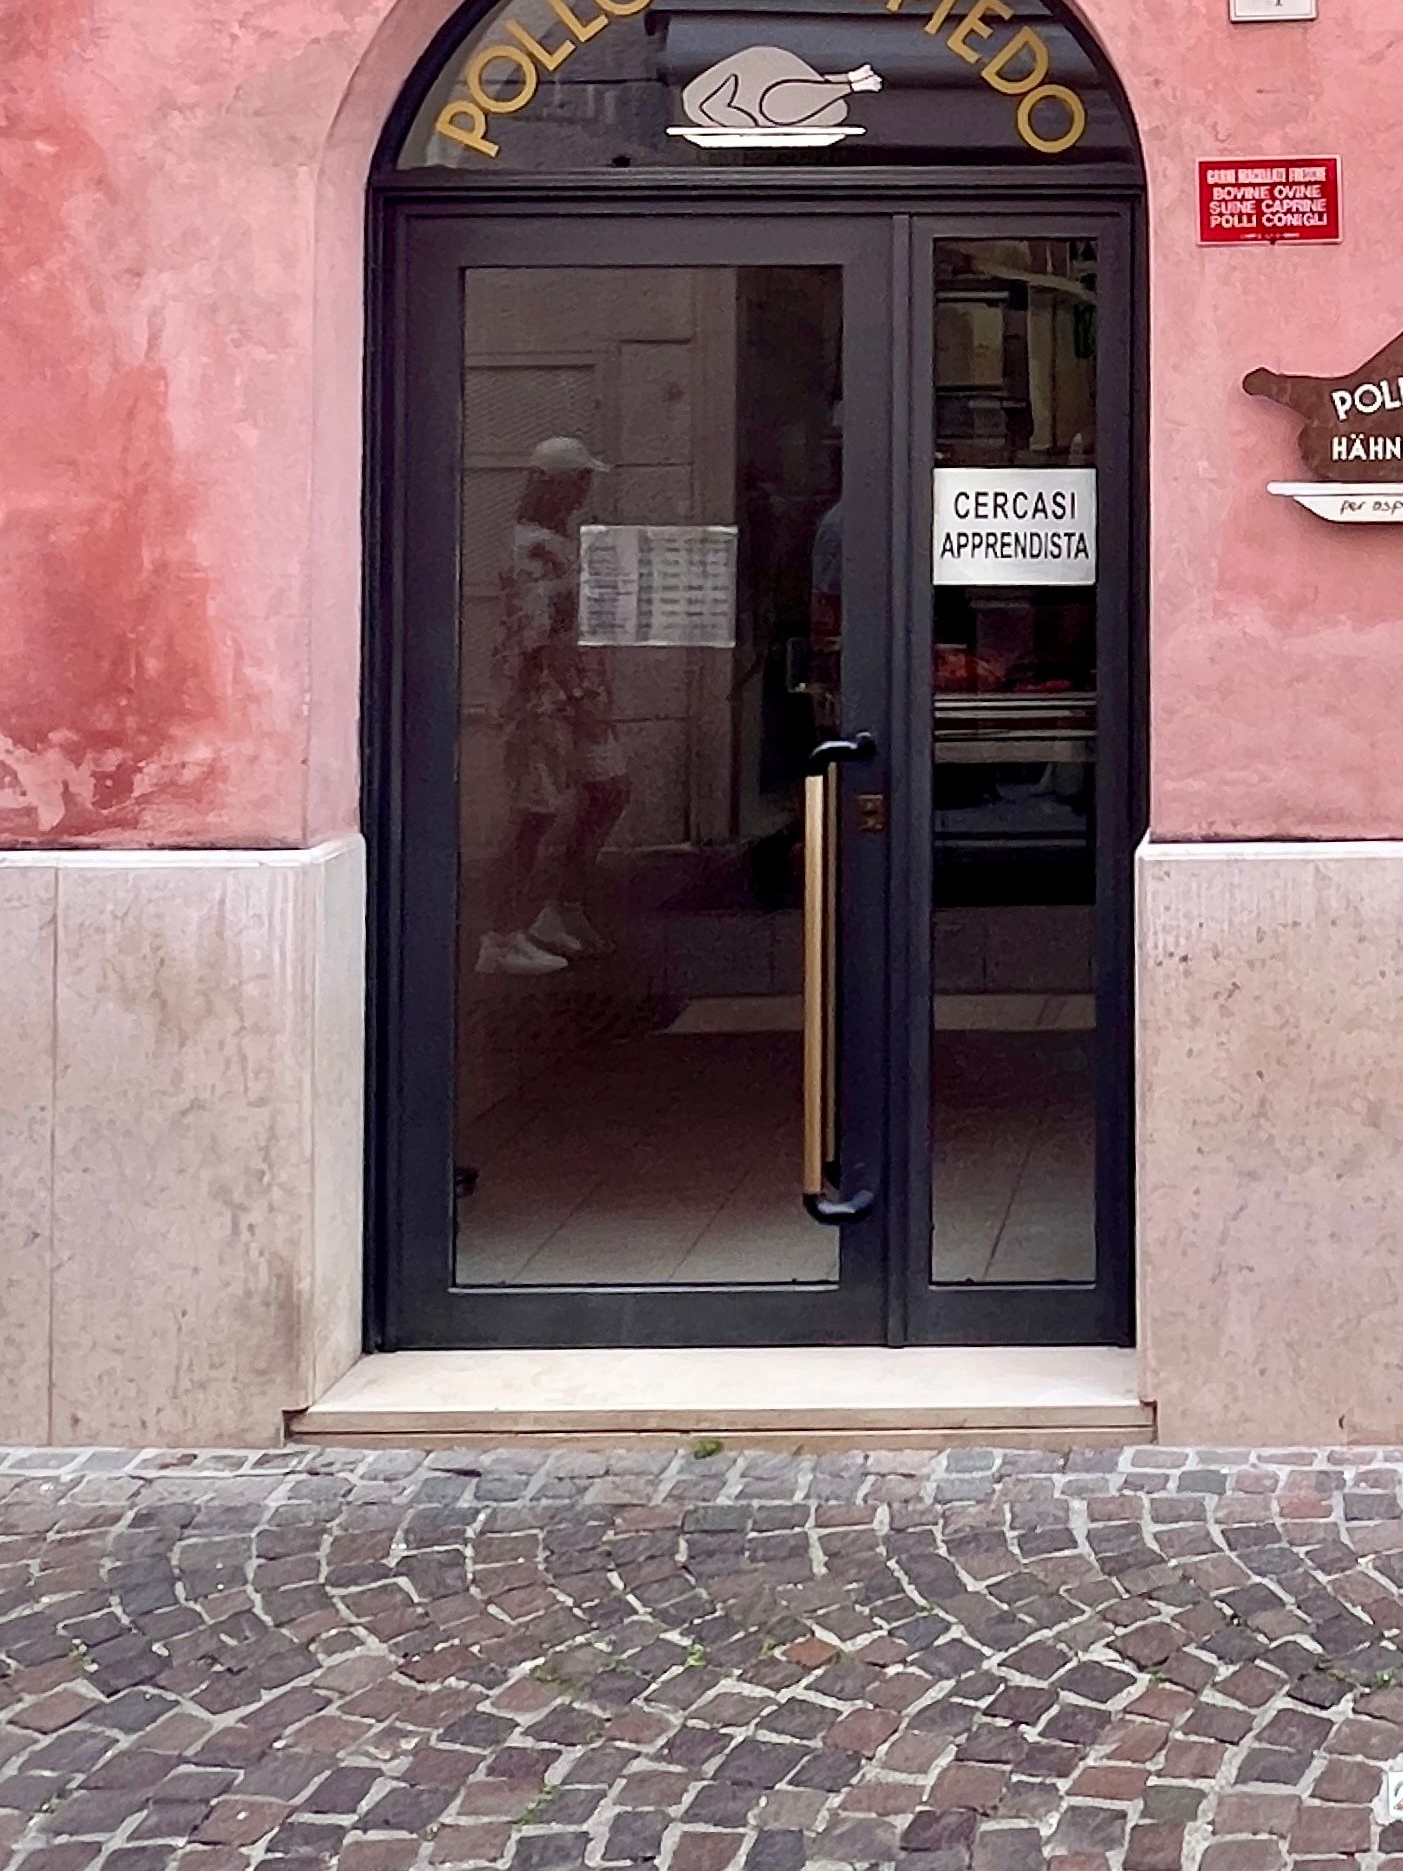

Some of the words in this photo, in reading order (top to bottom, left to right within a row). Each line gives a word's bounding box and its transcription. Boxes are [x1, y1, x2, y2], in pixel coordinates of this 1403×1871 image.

[1212, 186, 1271, 200] BOVINE
[1273, 184, 1322, 199] OVINE
[1208, 200, 1257, 214] SUINE
[1261, 198, 1327, 213] CAPRINE
[1209, 214, 1257, 228] POLLI
[1261, 213, 1328, 227] CONIGLI
[953, 491, 1077, 520] CERCASI
[1339, 499, 1367, 515] per
[940, 531, 1090, 560] APPRENDISTA
